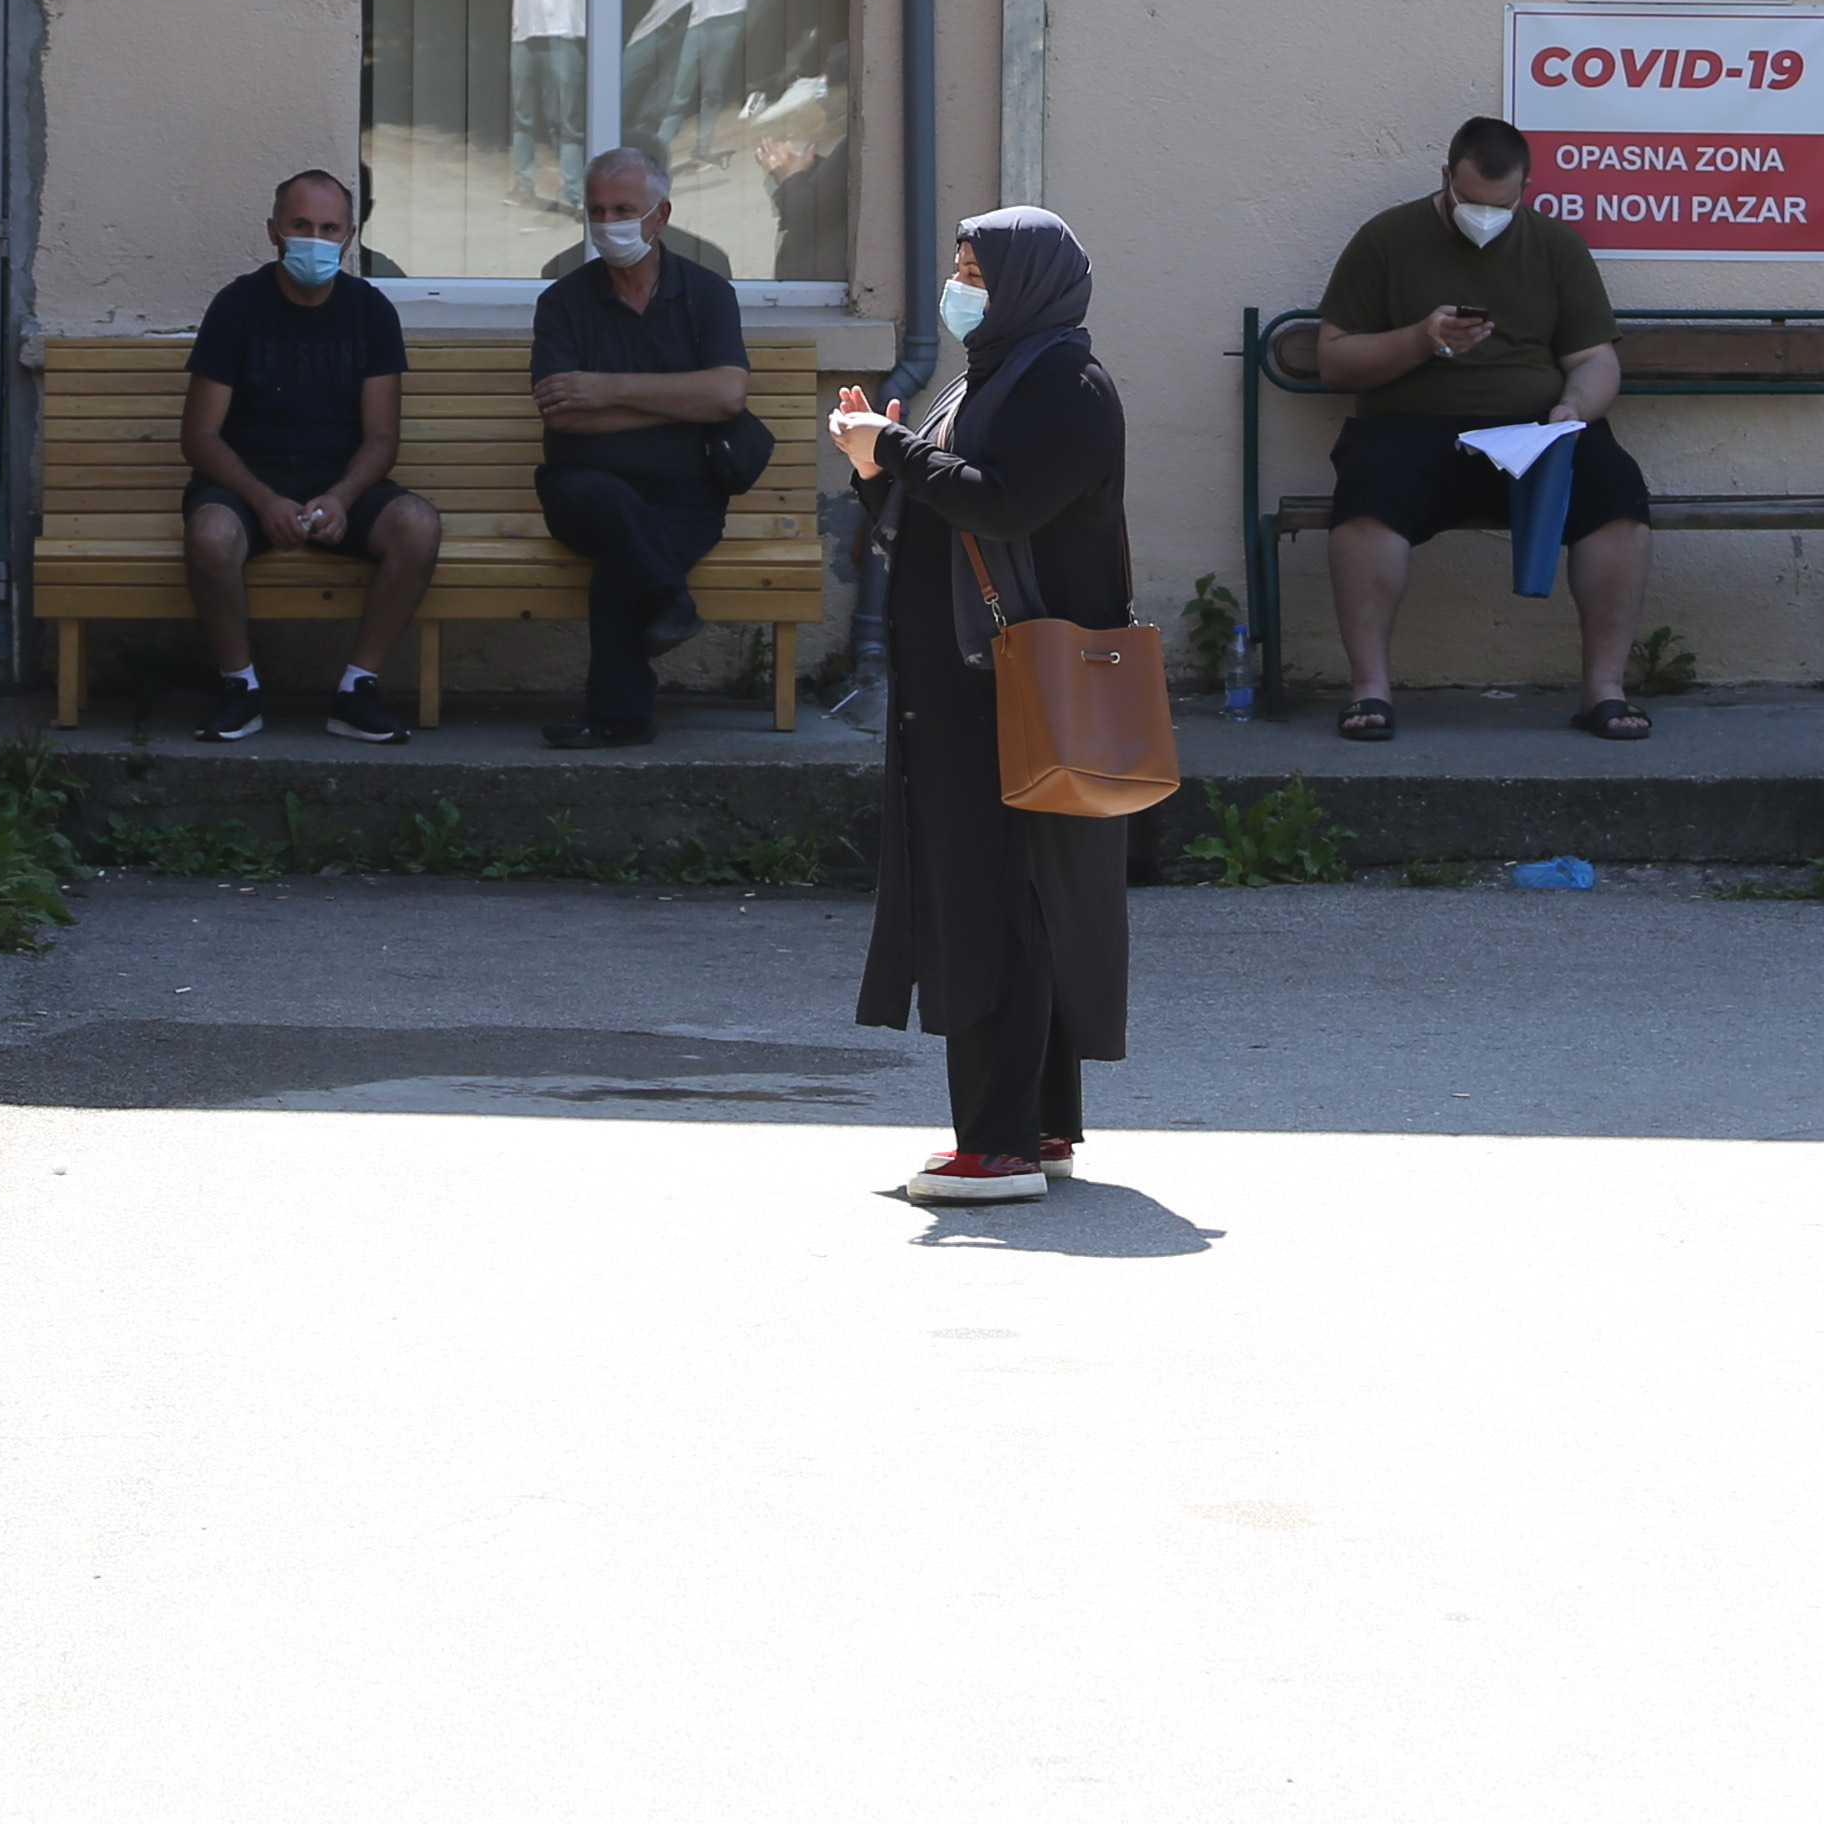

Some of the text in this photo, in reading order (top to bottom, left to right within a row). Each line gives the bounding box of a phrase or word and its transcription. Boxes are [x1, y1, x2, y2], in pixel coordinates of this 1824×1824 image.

[1530, 46, 1804, 91] COVID-19
[1556, 144, 1785, 172] OPASNA ZONA
[1533, 193, 1808, 224] OB NOVI PAZAR
